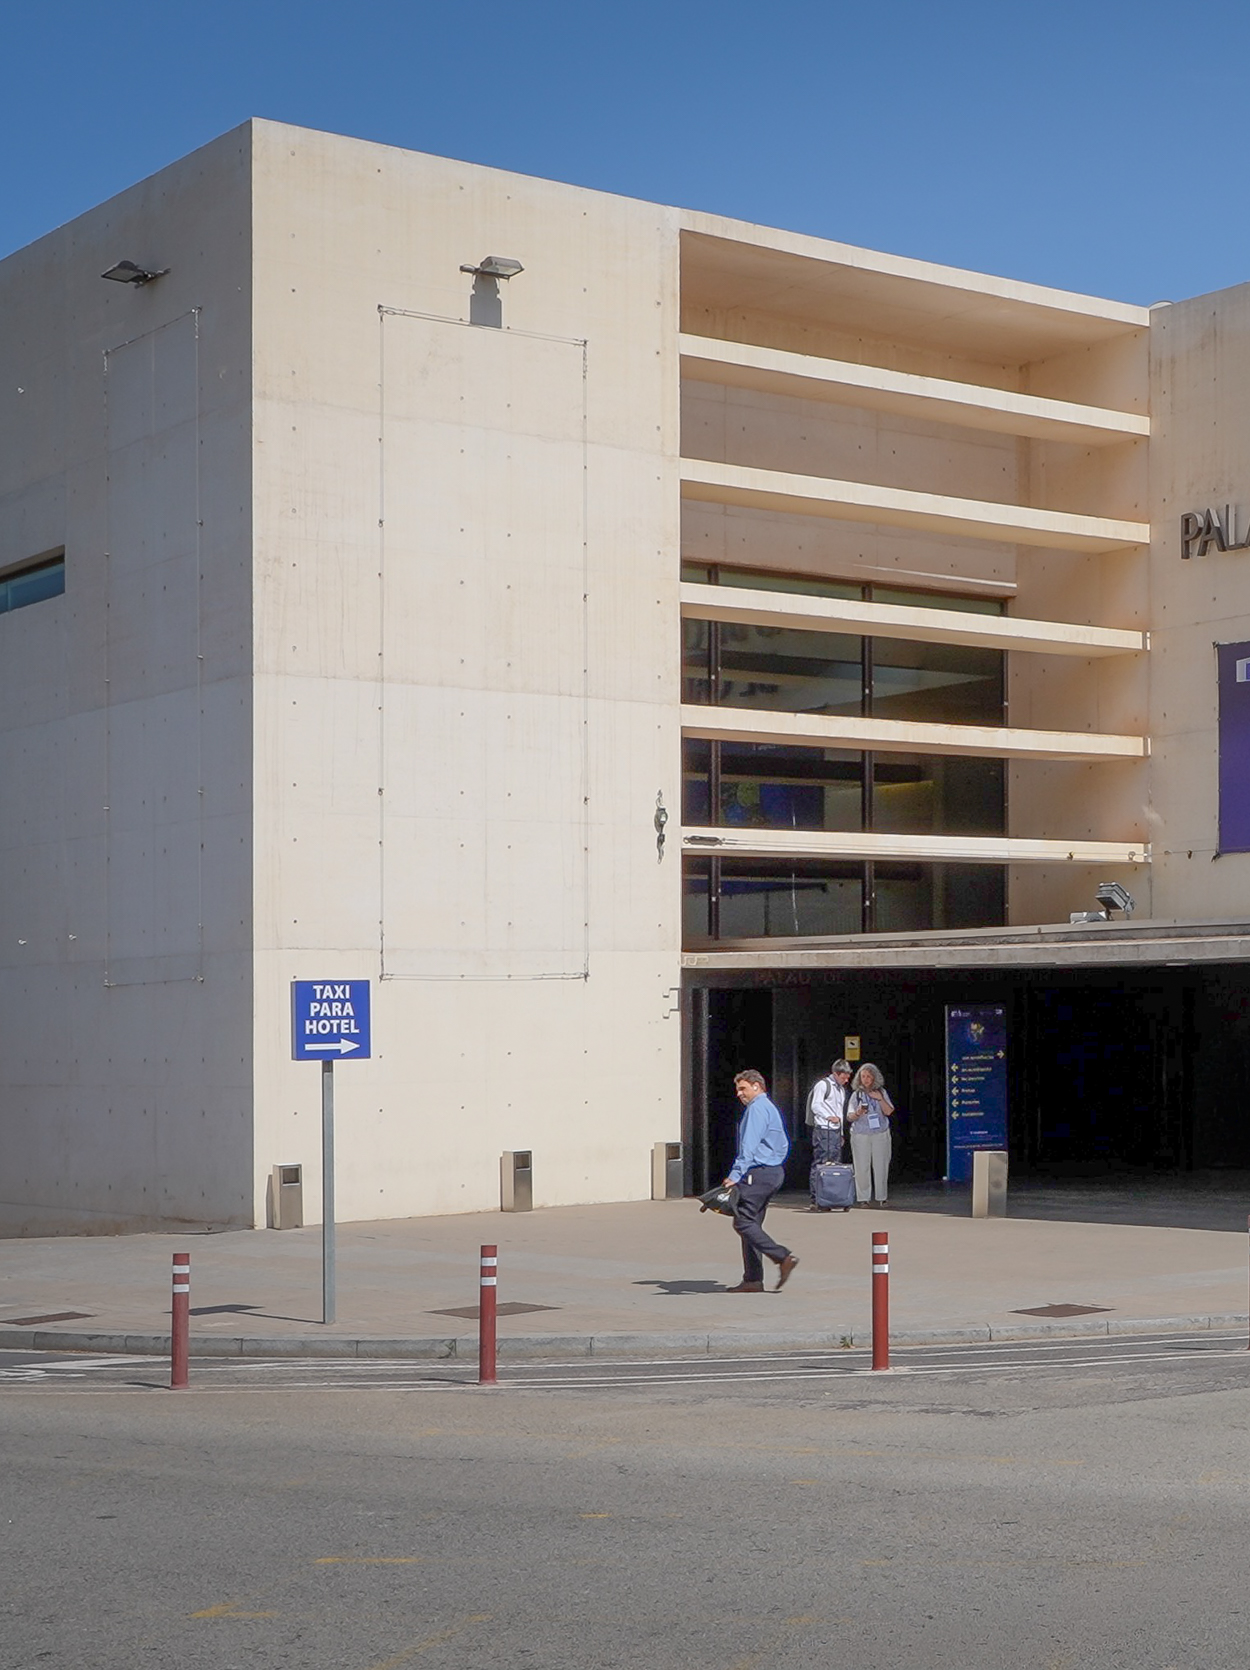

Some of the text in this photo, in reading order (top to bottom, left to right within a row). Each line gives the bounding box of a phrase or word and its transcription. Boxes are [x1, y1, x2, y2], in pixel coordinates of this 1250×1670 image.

[313, 985, 350, 999] TAXI
[310, 1002, 354, 1016] PARA
[305, 1020, 360, 1034] HOTEL
